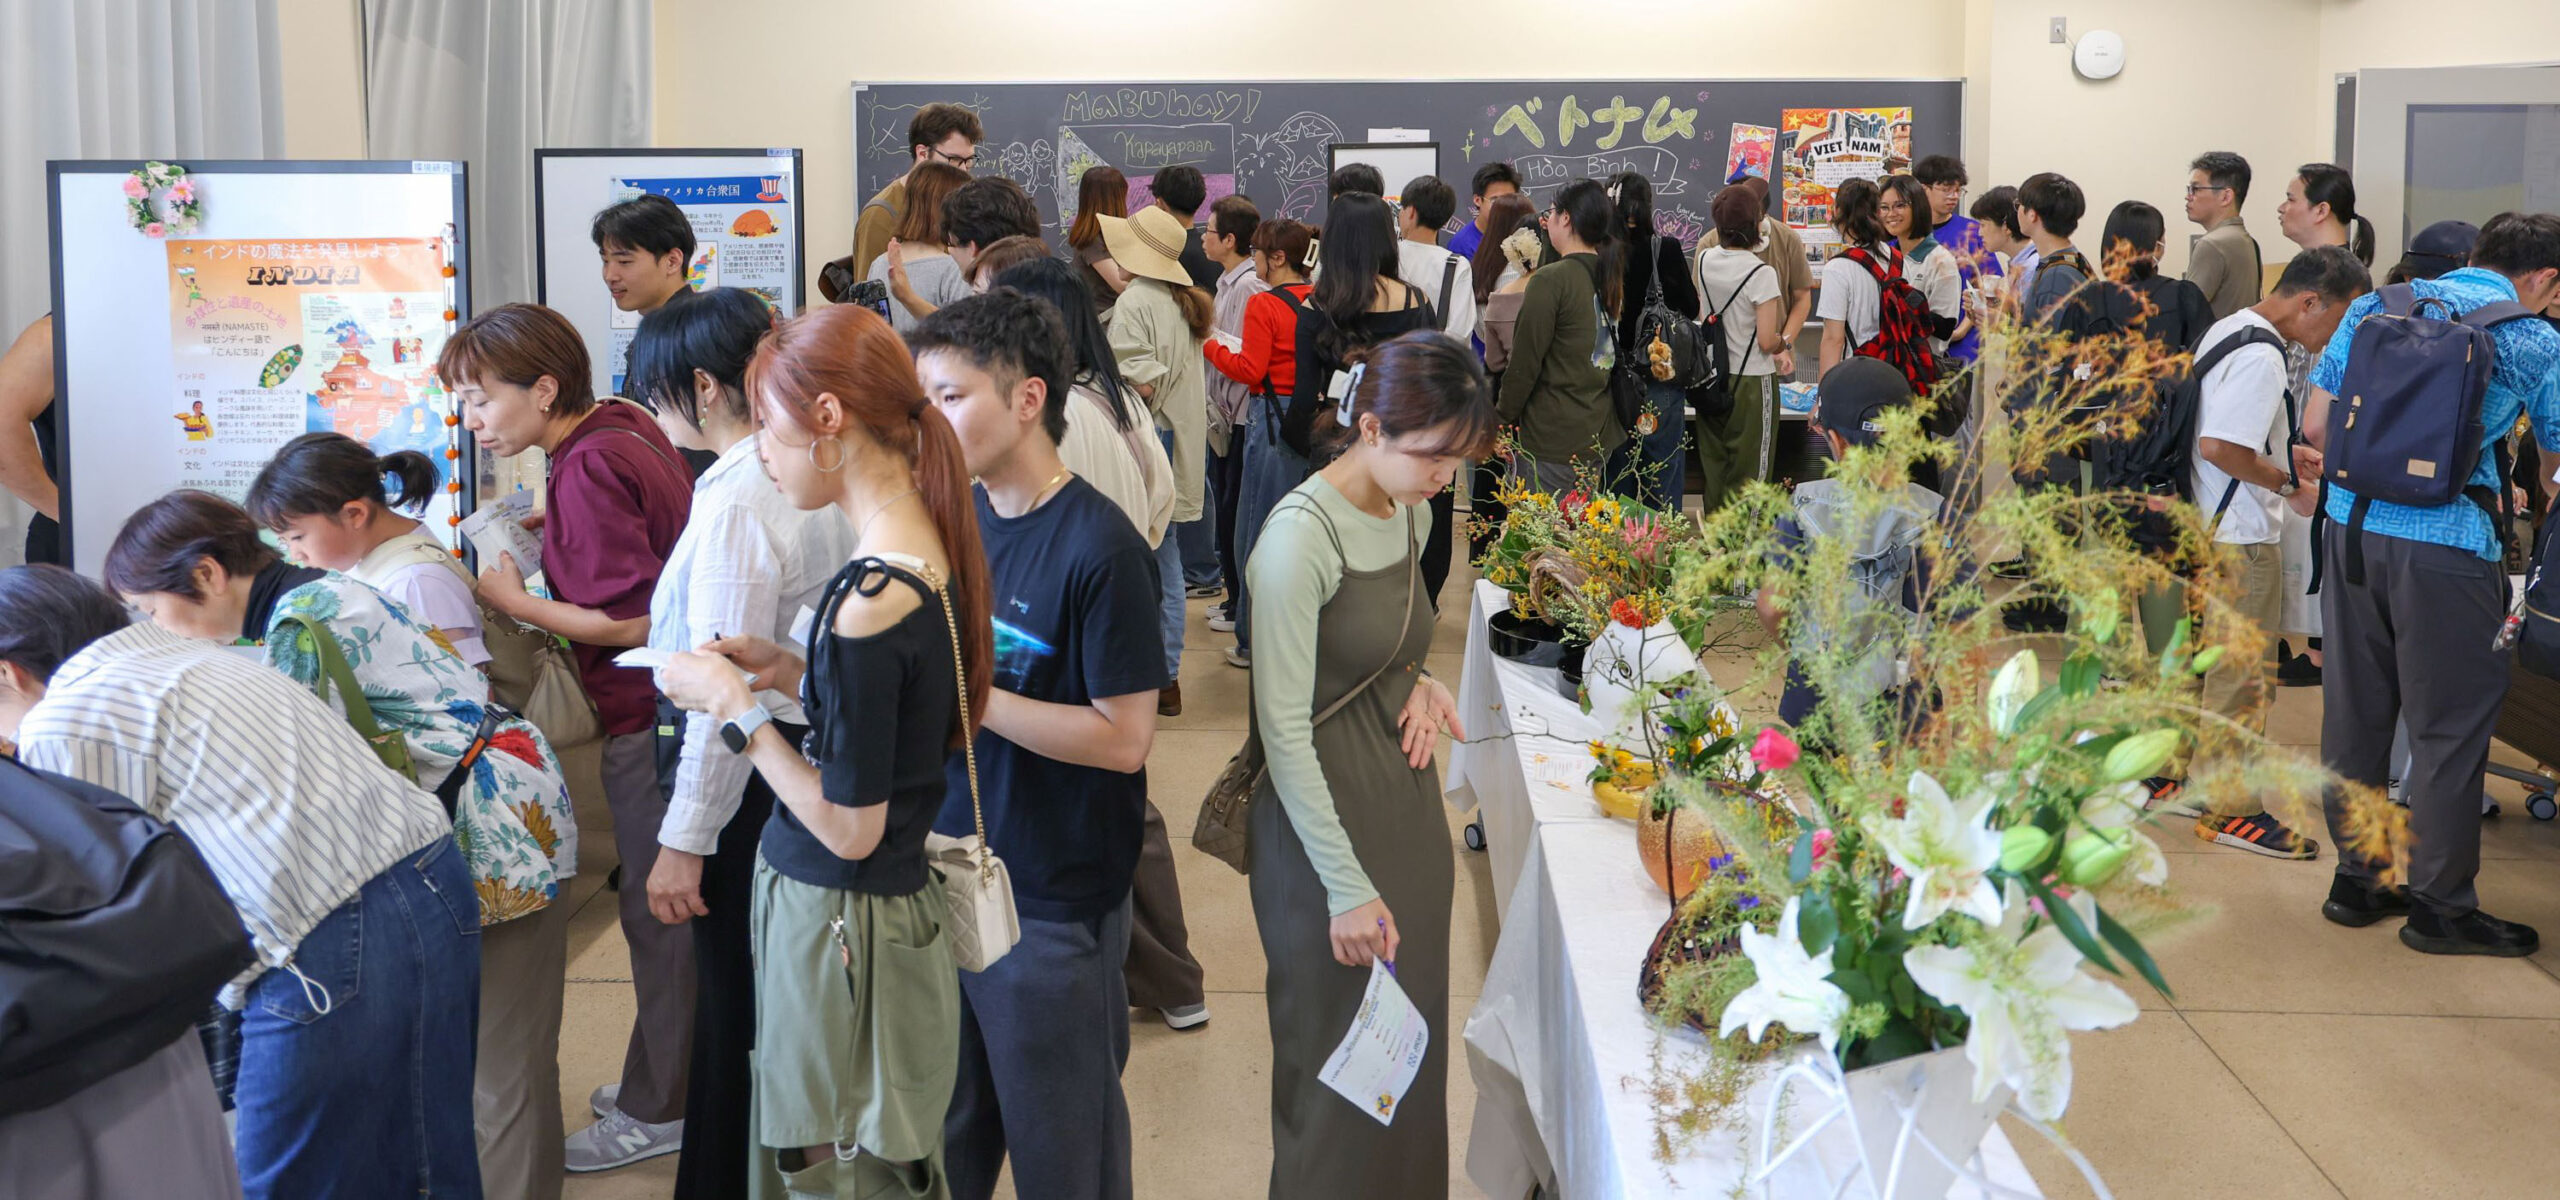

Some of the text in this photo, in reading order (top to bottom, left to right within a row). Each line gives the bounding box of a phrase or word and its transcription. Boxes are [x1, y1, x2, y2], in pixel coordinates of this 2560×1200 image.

[1493, 94, 1698, 150] ベトナム
[1113, 131, 1216, 166] Kapayapaan
[1814, 140, 1881, 156] VIET NAM
[1527, 157, 1569, 180] Hòa
[662, 184, 741, 198] アメリカ合衆国
[203, 243, 401, 260] インドの魔法を発見しよう
[247, 265, 361, 286] INDIA
[185, 295, 288, 329] 多様性と遺産の土地
[222, 322, 269, 331] (NAMASTE)
[203, 335, 272, 345] はヒンディー語で
[184, 389, 201, 399] 料理
[184, 461, 202, 471] 文化
